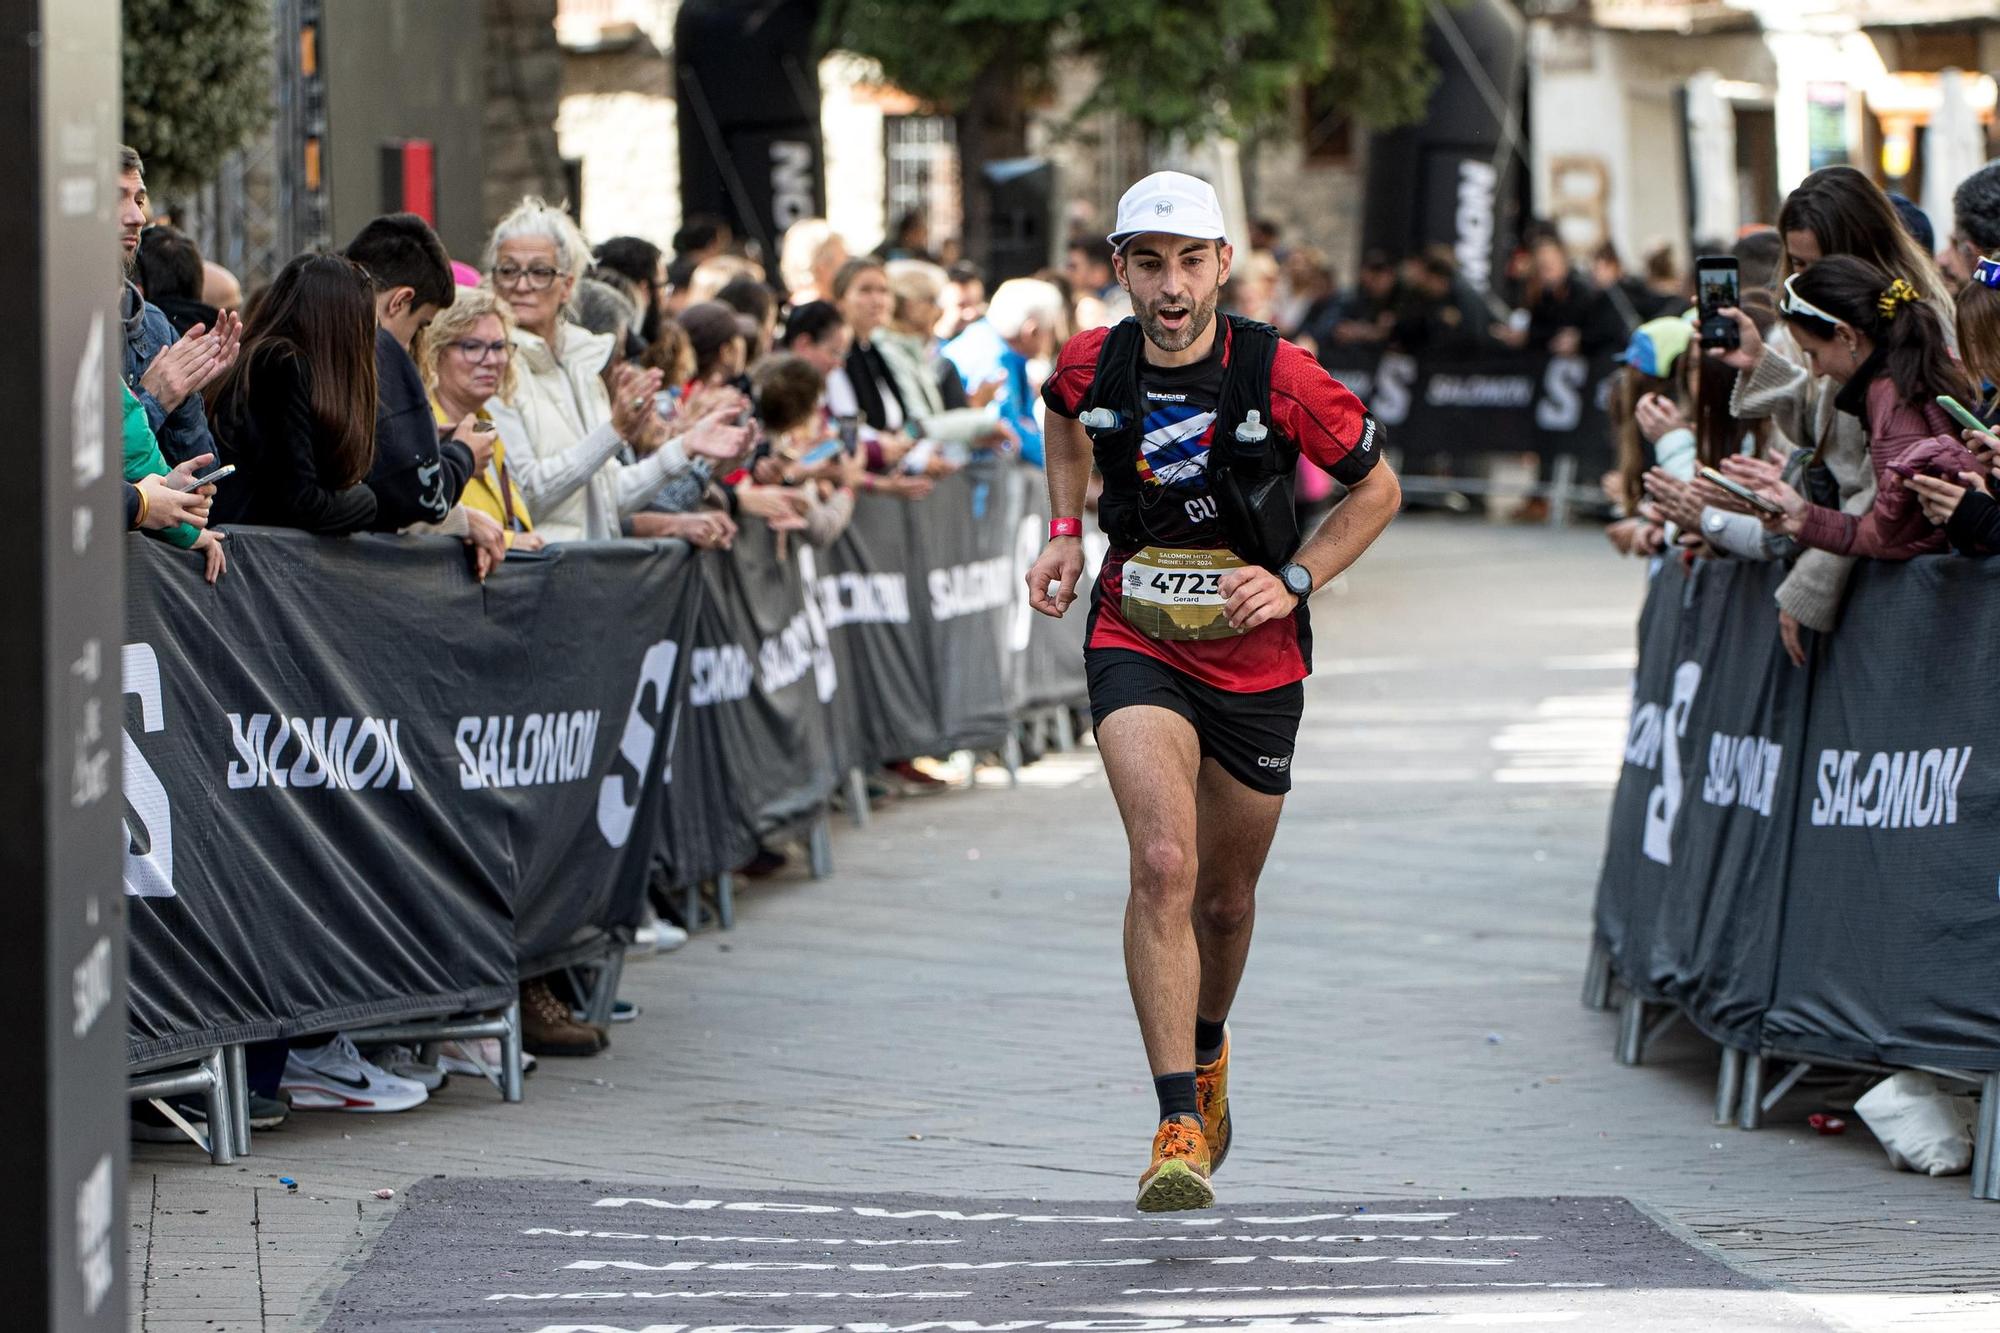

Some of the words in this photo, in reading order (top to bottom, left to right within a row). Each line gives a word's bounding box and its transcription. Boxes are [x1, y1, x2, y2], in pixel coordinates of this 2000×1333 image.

[1184, 495, 1218, 523] CU
[1157, 558, 1184, 566] PIRINEU
[1150, 572, 1222, 594] 4723
[454, 709, 601, 791] SALOMON
[1811, 746, 1973, 829] SALOMON
[589, 1197, 1461, 1225] SALOMON
[520, 1228, 966, 1246] SALOMON
[560, 1255, 1518, 1272] SALOMON
[483, 1291, 973, 1301] SALOMON
